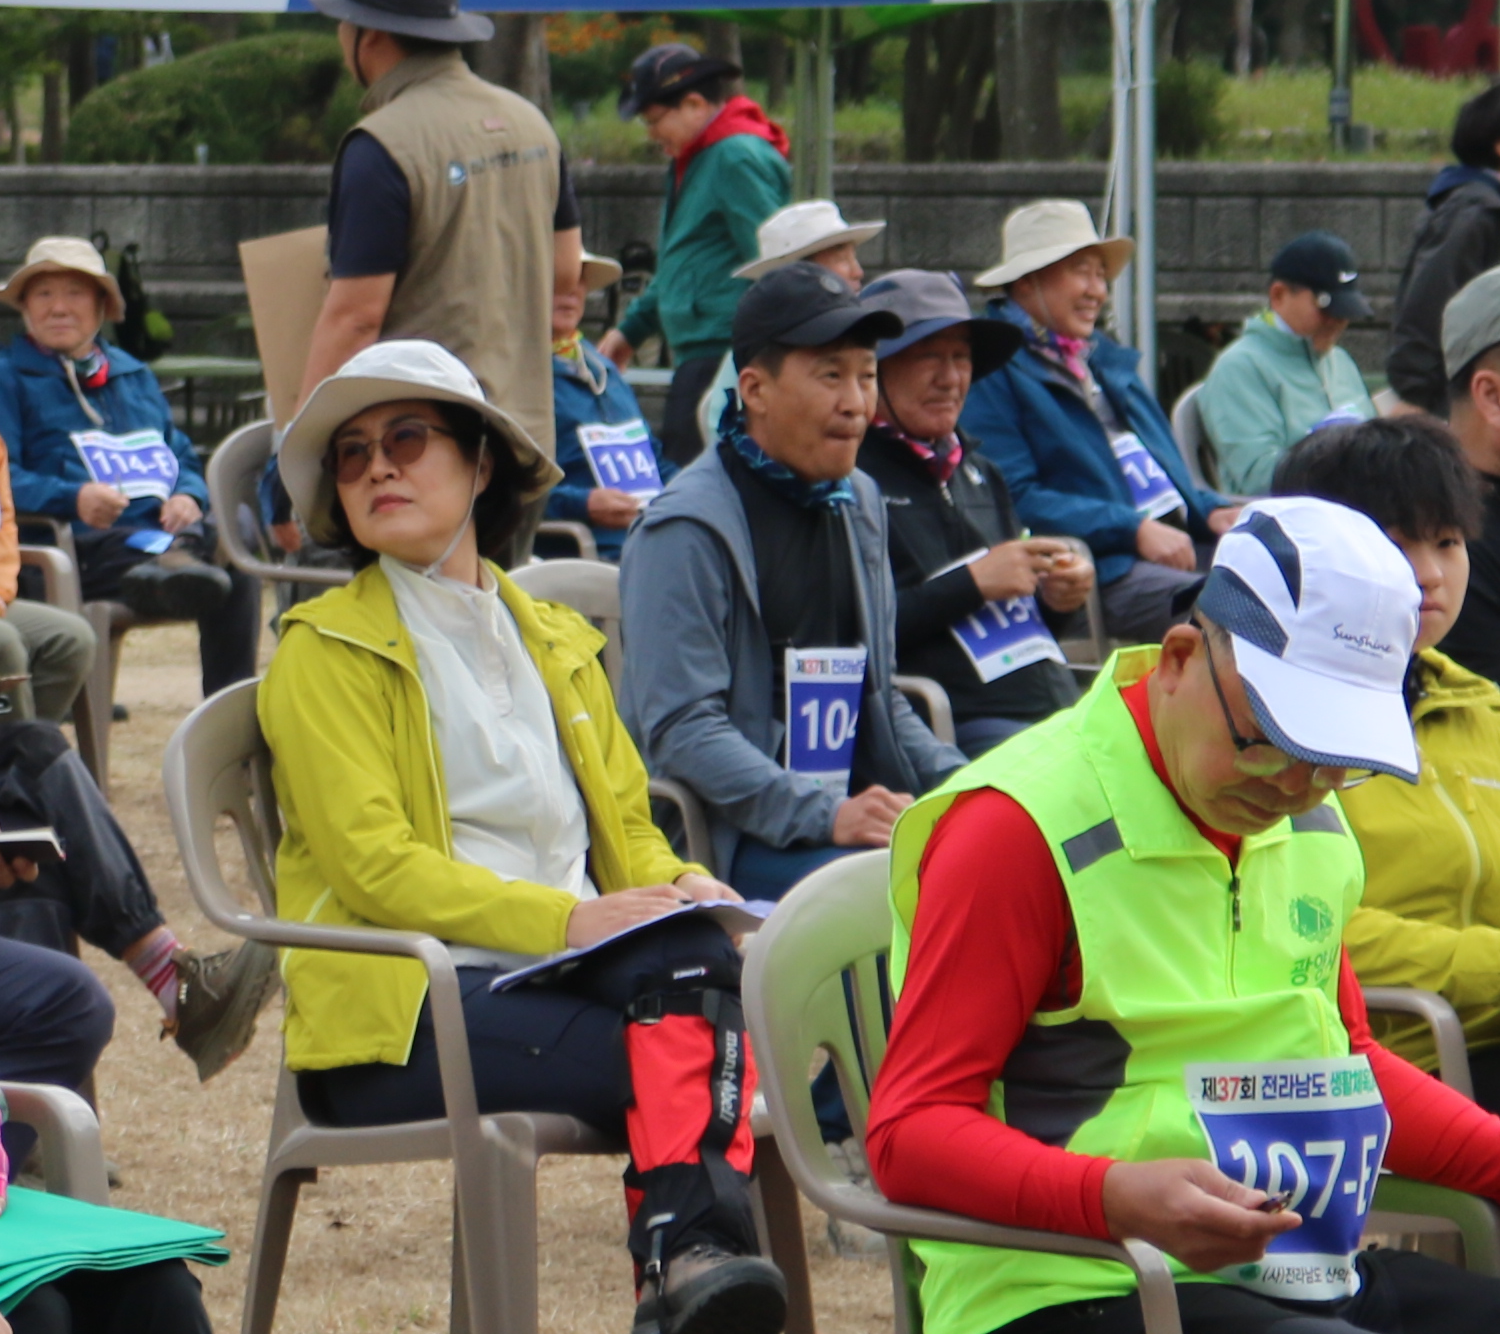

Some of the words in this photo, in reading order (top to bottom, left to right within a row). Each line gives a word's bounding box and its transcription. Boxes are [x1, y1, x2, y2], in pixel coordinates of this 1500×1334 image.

[1200, 1074, 1257, 1102] 제37회
[1261, 1072, 1327, 1101] 전라남도
[1261, 1267, 1323, 1285] (사)전라남도
